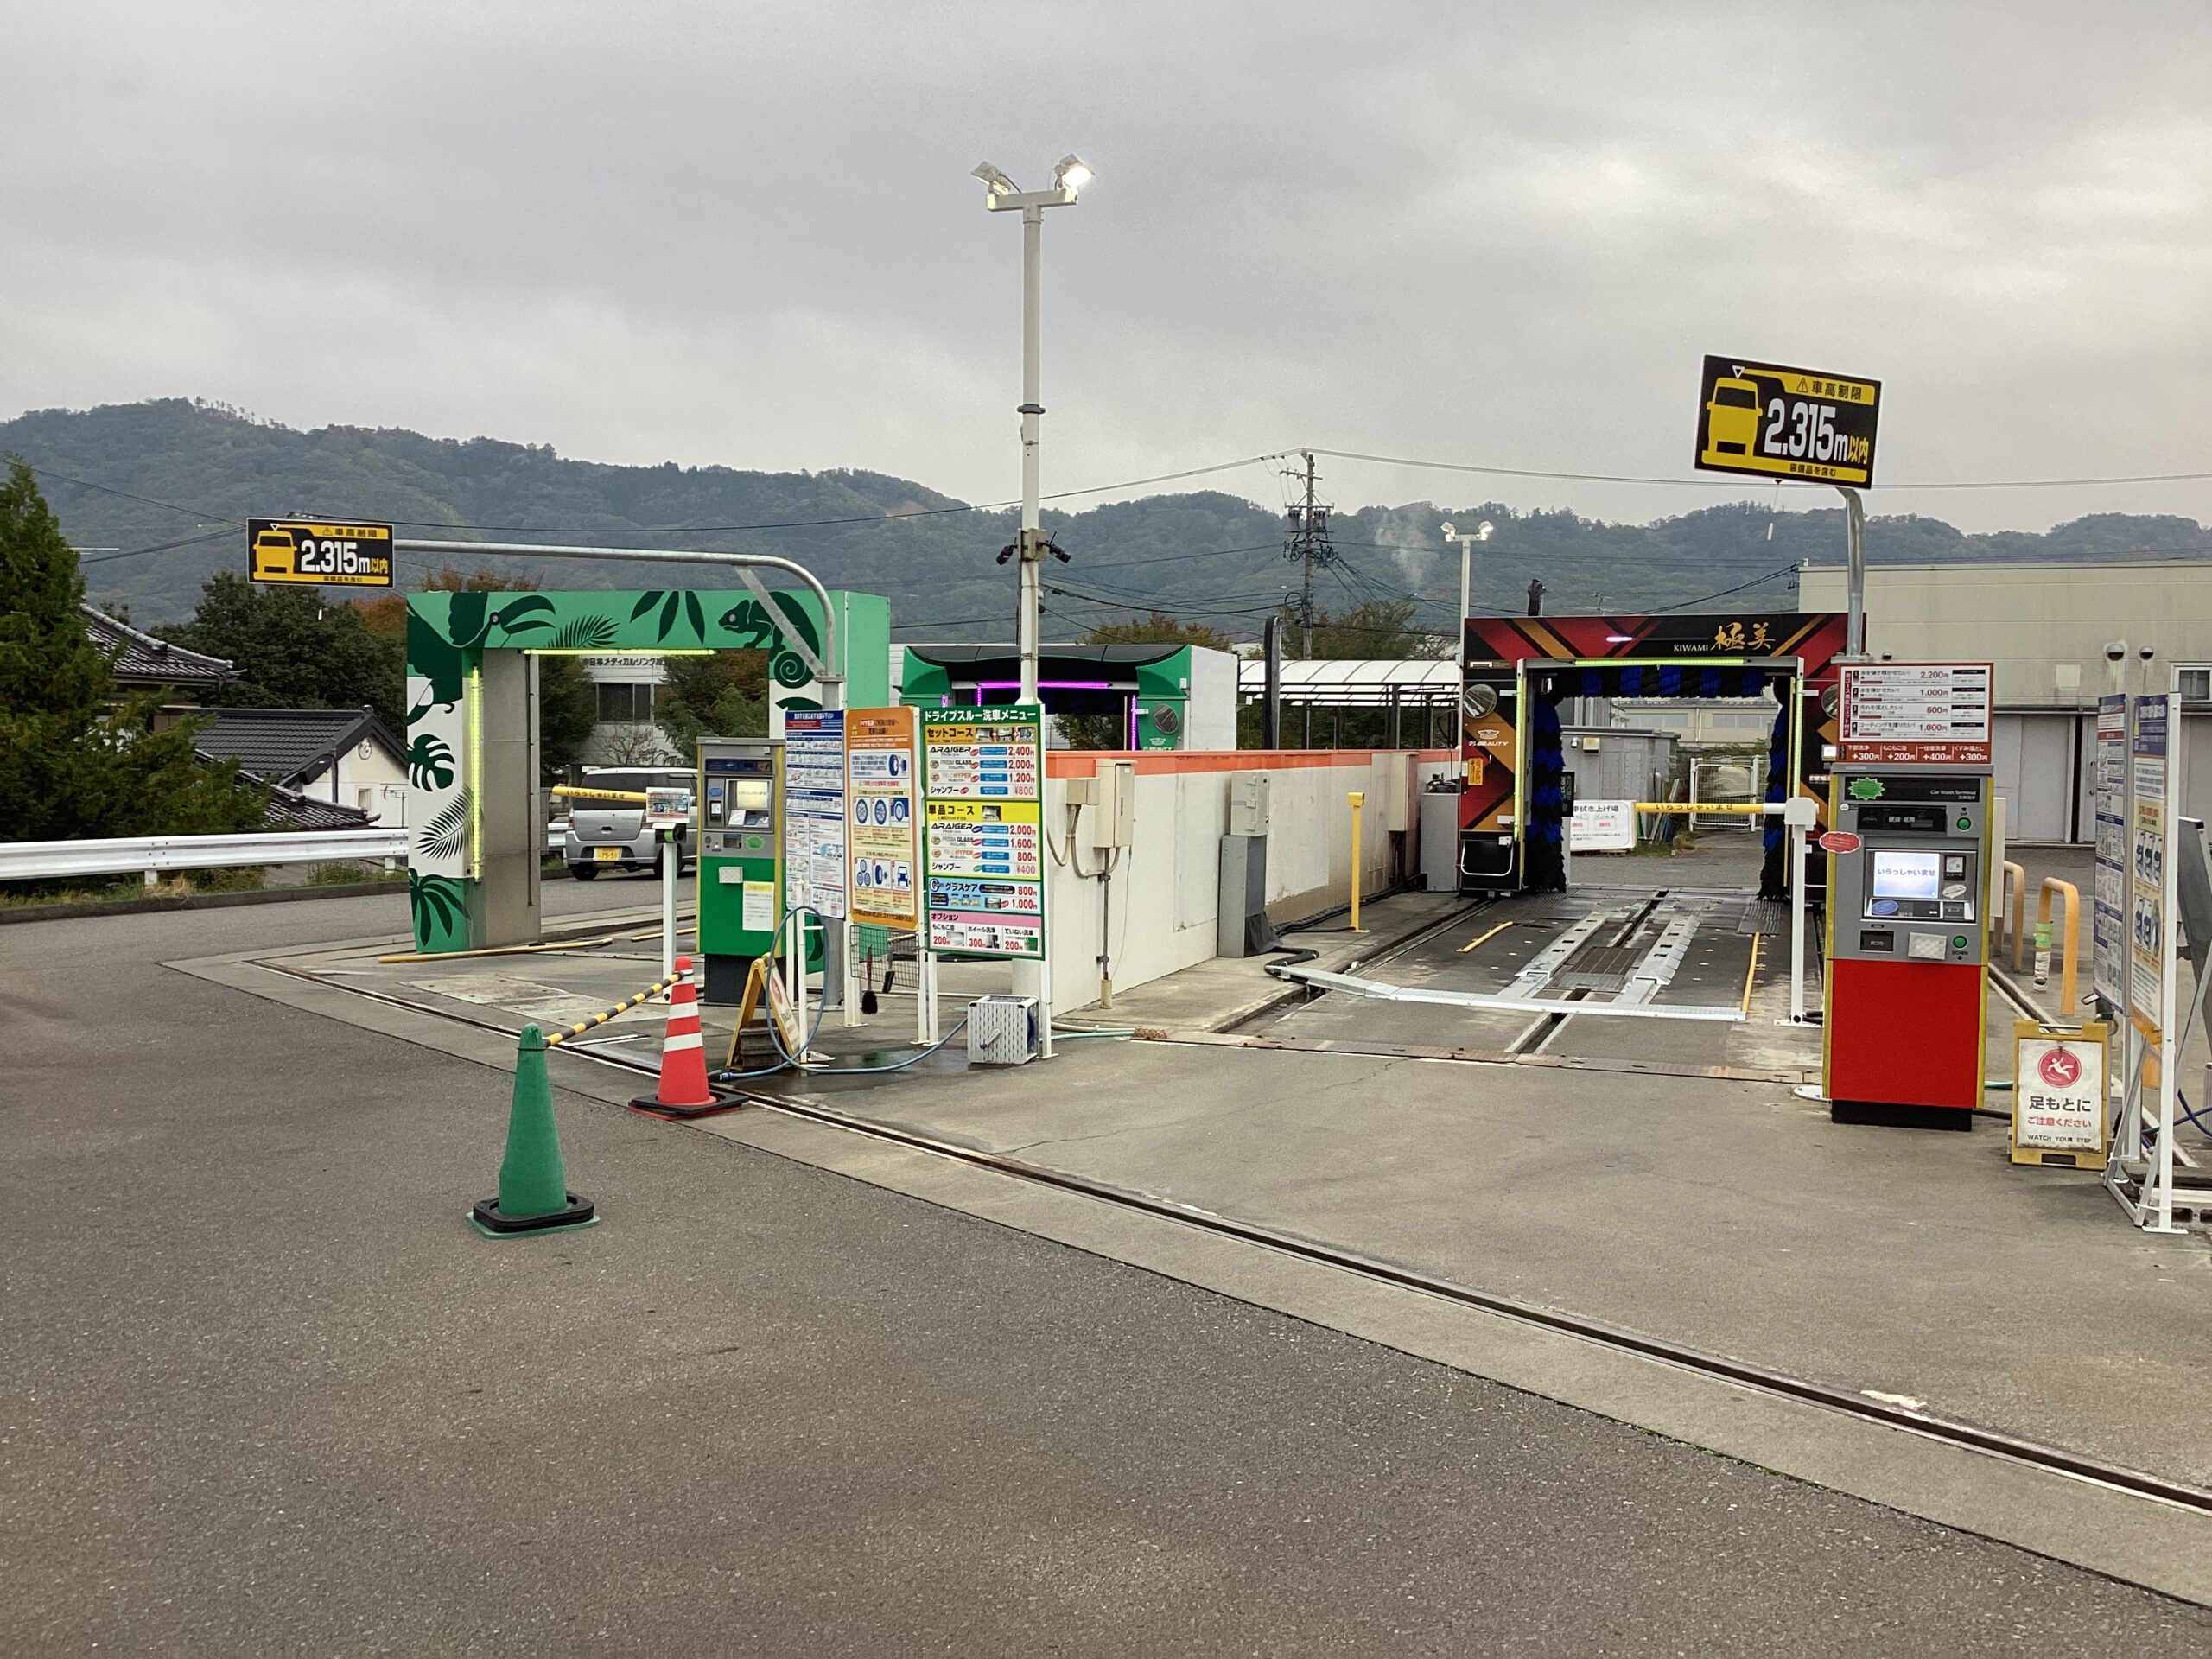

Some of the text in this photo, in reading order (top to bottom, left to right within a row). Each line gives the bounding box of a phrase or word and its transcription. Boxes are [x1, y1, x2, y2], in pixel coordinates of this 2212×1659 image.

[1811, 379, 1862, 401] 車高制限
[1764, 397, 1870, 465] 2.315m以内
[1789, 463, 1837, 477] 装備品を含む
[334, 528, 378, 537] 車高制限
[301, 539, 388, 574] 2.315m以内
[1710, 621, 1776, 651] 極美
[925, 709, 1037, 722] ドライブスルー洗車メニュー
[927, 728, 974, 738] セットコース
[567, 789, 626, 800] いらっしゃいませ
[928, 804, 975, 816] 単品コース
[1017, 852, 1037, 861] 800円
[931, 862, 961, 871] シャンプー
[1878, 868, 1936, 877] いらっしゃいませ
[931, 912, 959, 922] オプション
[933, 935, 950, 945] 200円
[1005, 940, 1023, 950] 200円
[2029, 1096, 2092, 1113] 足もとに
[2027, 1116, 2092, 1128] ご注意ください
